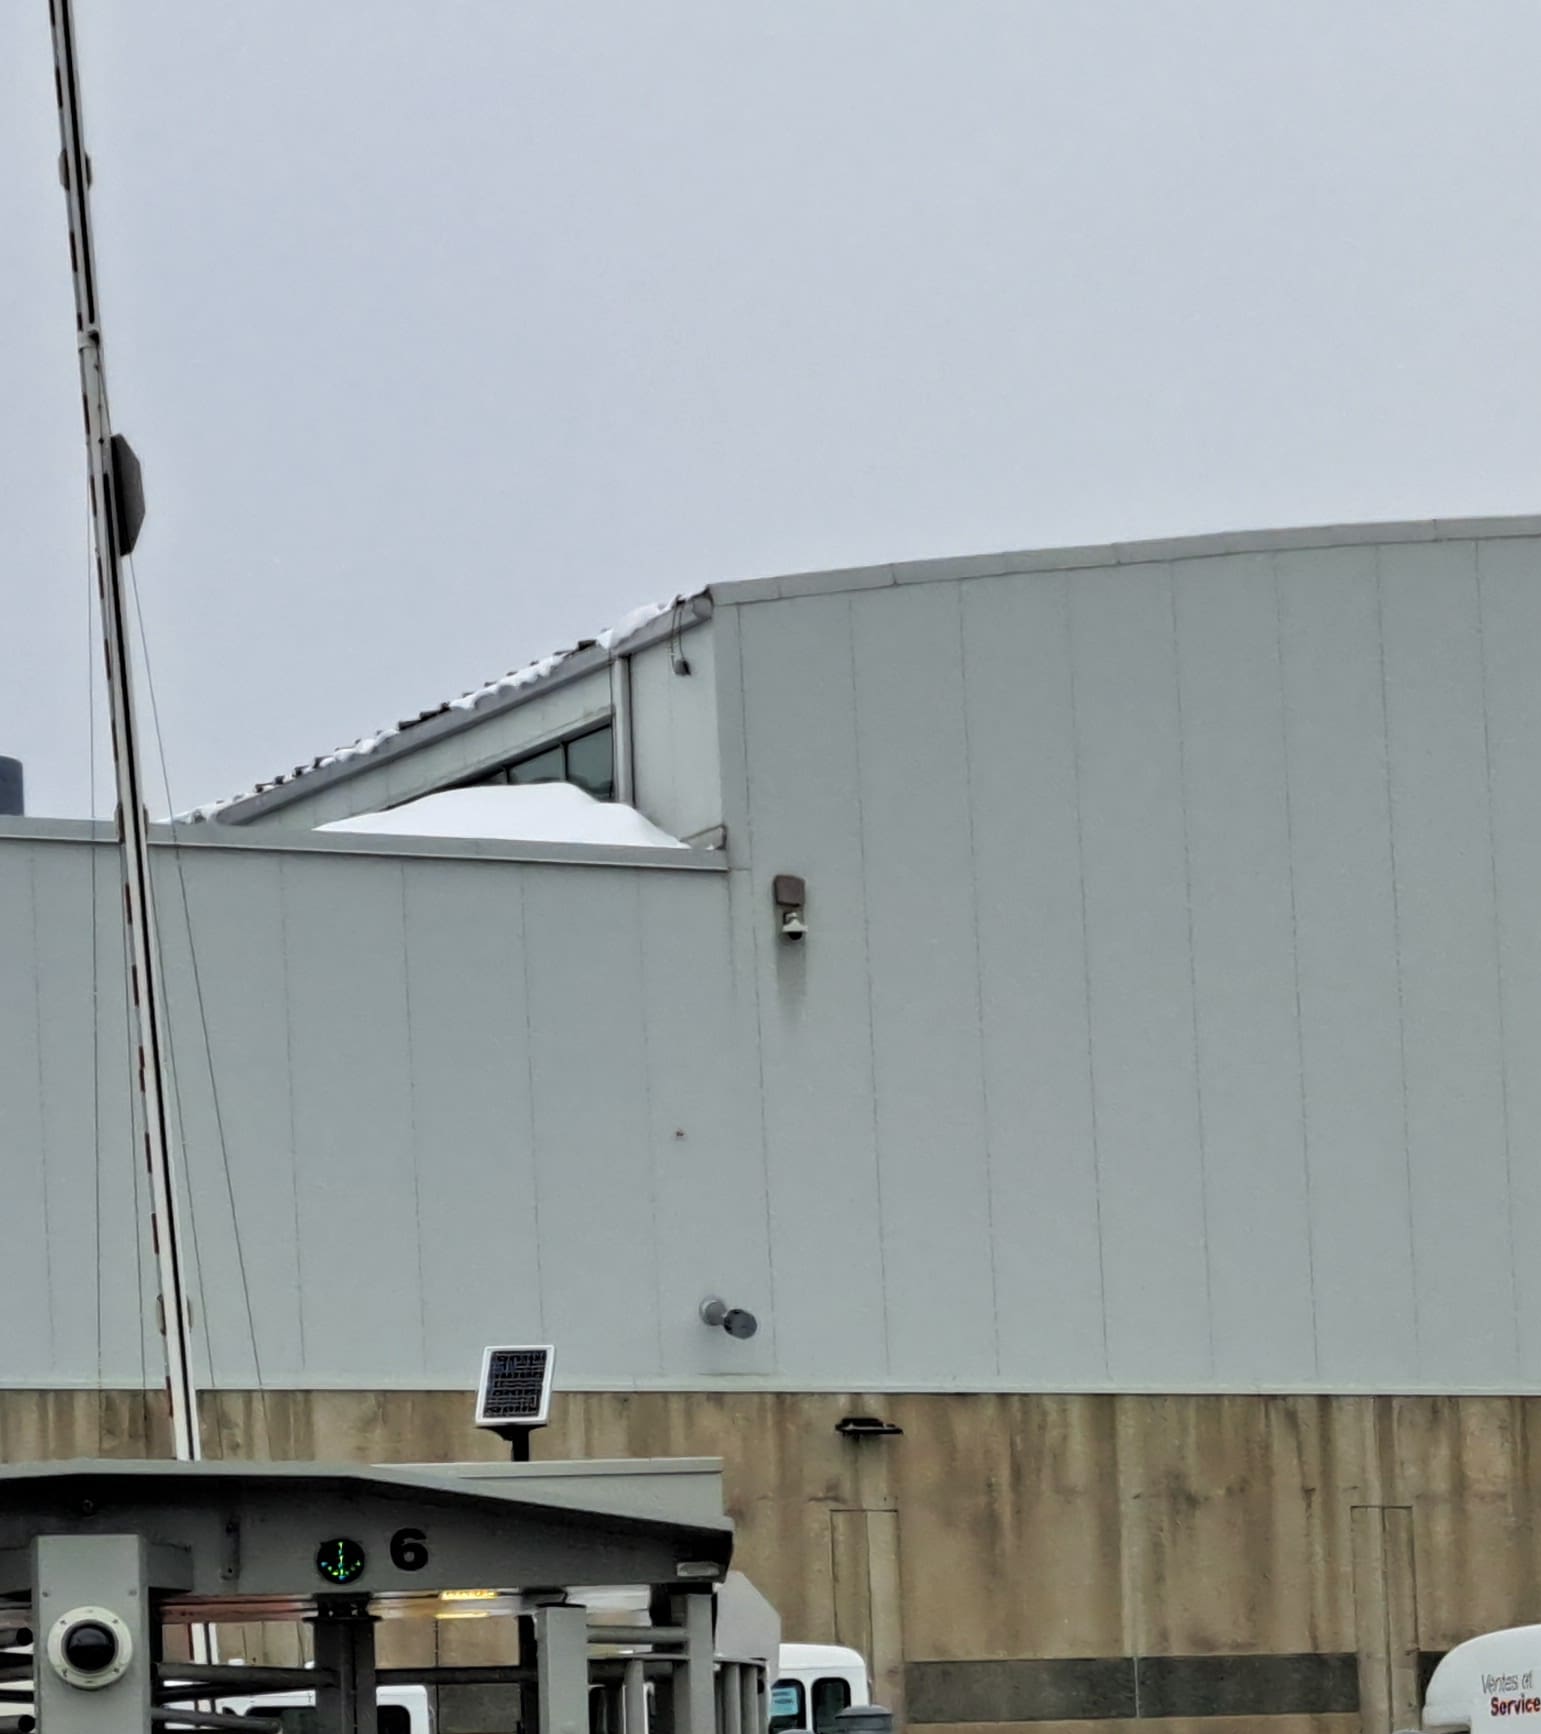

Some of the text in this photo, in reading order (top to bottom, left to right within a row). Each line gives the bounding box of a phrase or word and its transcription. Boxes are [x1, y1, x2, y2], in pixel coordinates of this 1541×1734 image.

[389, 1527, 429, 1572] 6
[1481, 1673, 1519, 1694] Ventes
[1490, 1694, 1541, 1717] Service
